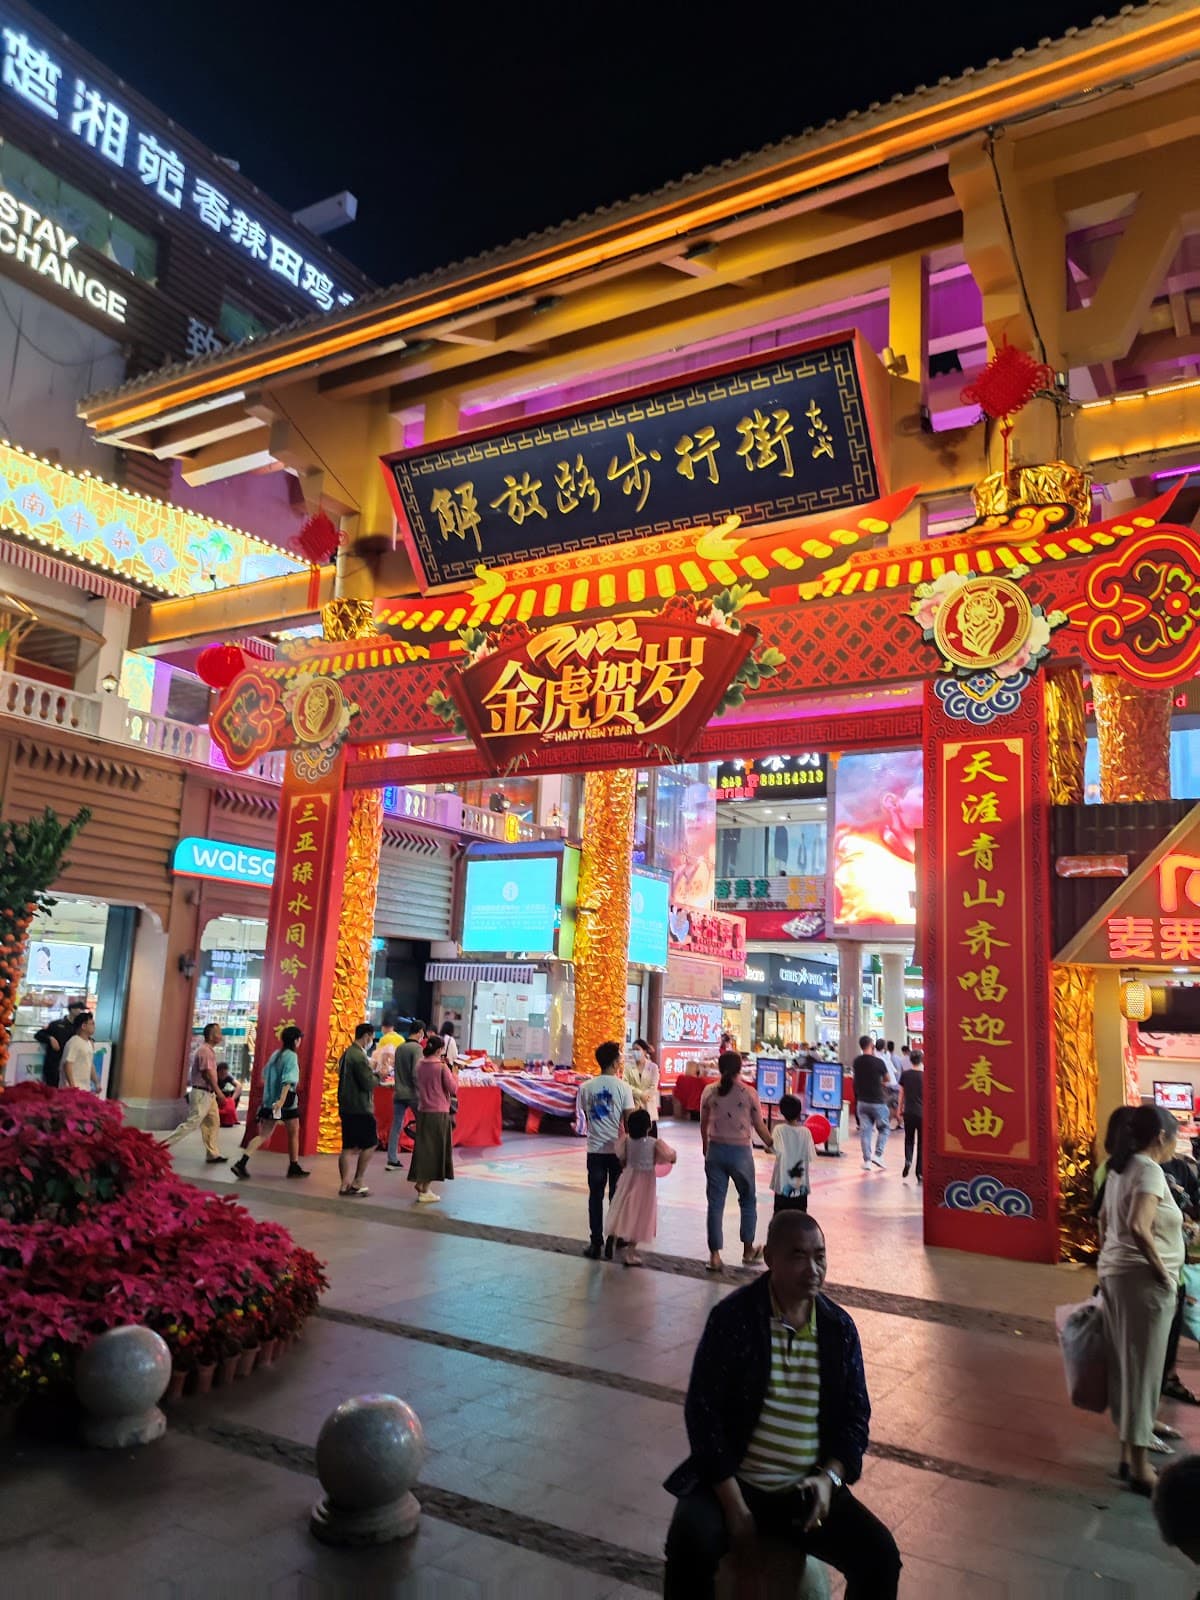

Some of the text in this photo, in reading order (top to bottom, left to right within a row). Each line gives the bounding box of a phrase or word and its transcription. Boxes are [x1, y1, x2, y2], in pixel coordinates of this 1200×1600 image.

[0, 191, 79, 259] STAY
[429, 408, 795, 553] 解放路步行街
[527, 619, 643, 669] 2022
[480, 636, 708, 739] 金虎贺岁
[555, 725, 633, 742] HAPPY NEW YEAR
[957, 750, 1015, 1140] 天涯青山齐唱迎春曲
[1108, 916, 1200, 960] 麦栗
